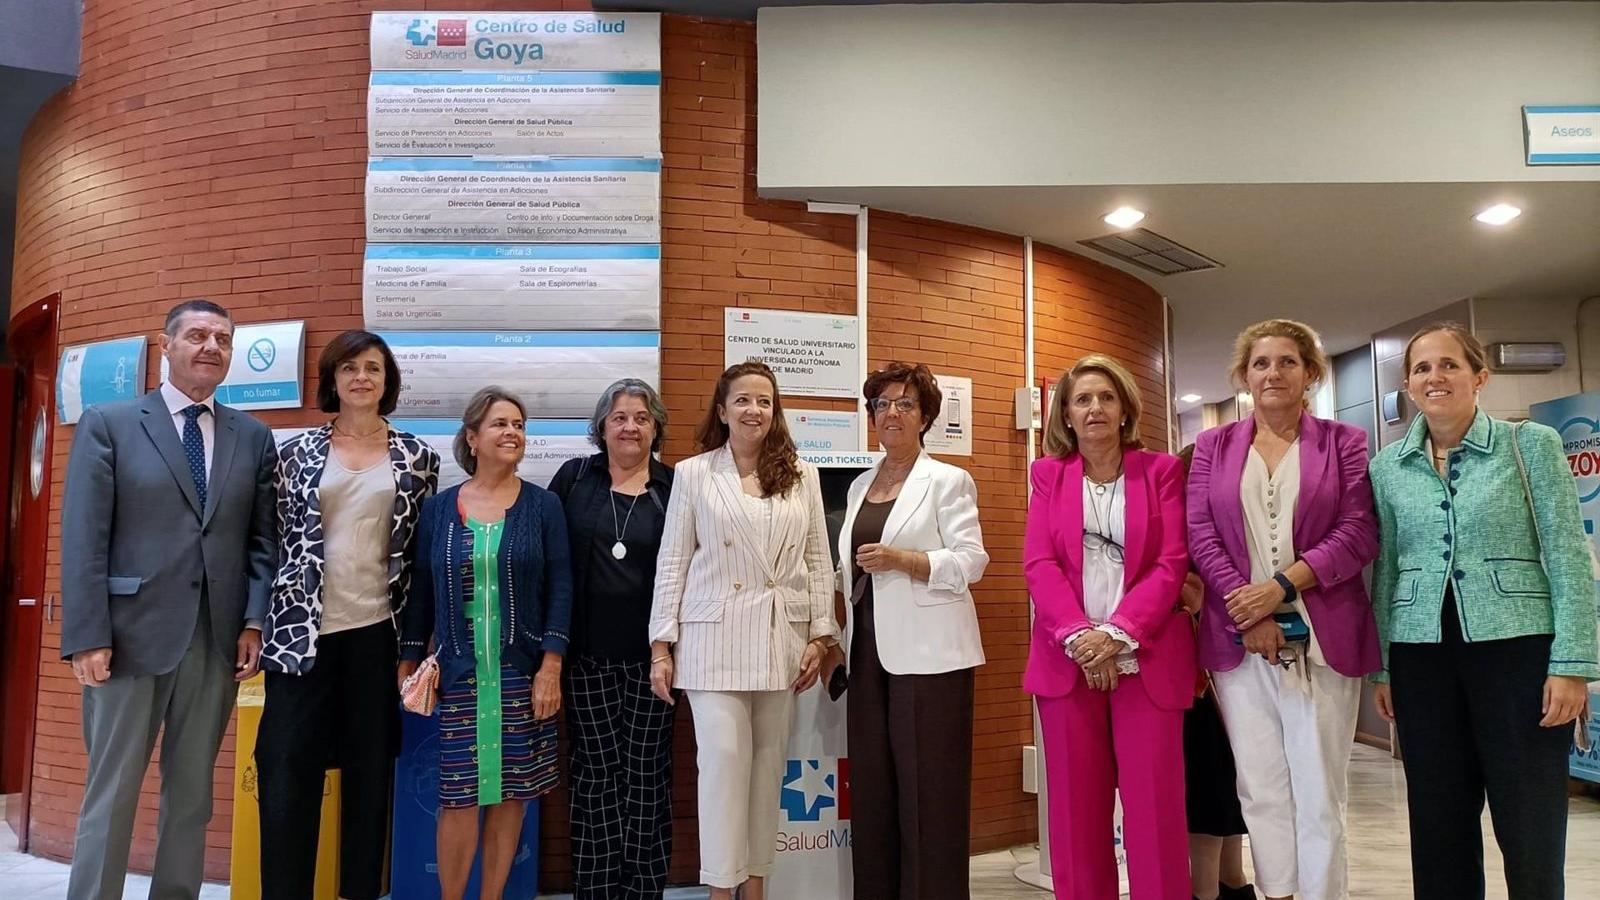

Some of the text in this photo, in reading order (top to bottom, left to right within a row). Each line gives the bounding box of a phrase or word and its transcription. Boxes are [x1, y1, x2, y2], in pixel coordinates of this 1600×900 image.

[475, 19, 625, 33] Centro de Salud
[405, 49, 467, 60] SaludMadrid
[474, 37, 544, 64] Goya
[1551, 126, 1592, 136] Aseos
[454, 142, 495, 150] Investigación
[448, 200, 580, 208] Dirección General de Salud Pública
[415, 227, 452, 235] Inspección
[496, 248, 532, 256] Planta 3
[549, 265, 587, 273] Ecografías
[548, 280, 597, 288] Espirometrías
[495, 335, 531, 343] Planta 2
[728, 336, 759, 344] CENTRO
[774, 338, 799, 346] SALUD
[801, 340, 856, 350] UNIVERSITARIO
[763, 347, 806, 355] VINCULADO
[746, 356, 840, 366] UNIVERSIDAD AUTÓNOMA
[243, 388, 280, 398] no fumar
[1563, 437, 1600, 450] MPROMIS
[836, 456, 872, 464] TICKETS
[776, 829, 854, 852] SaludMa
